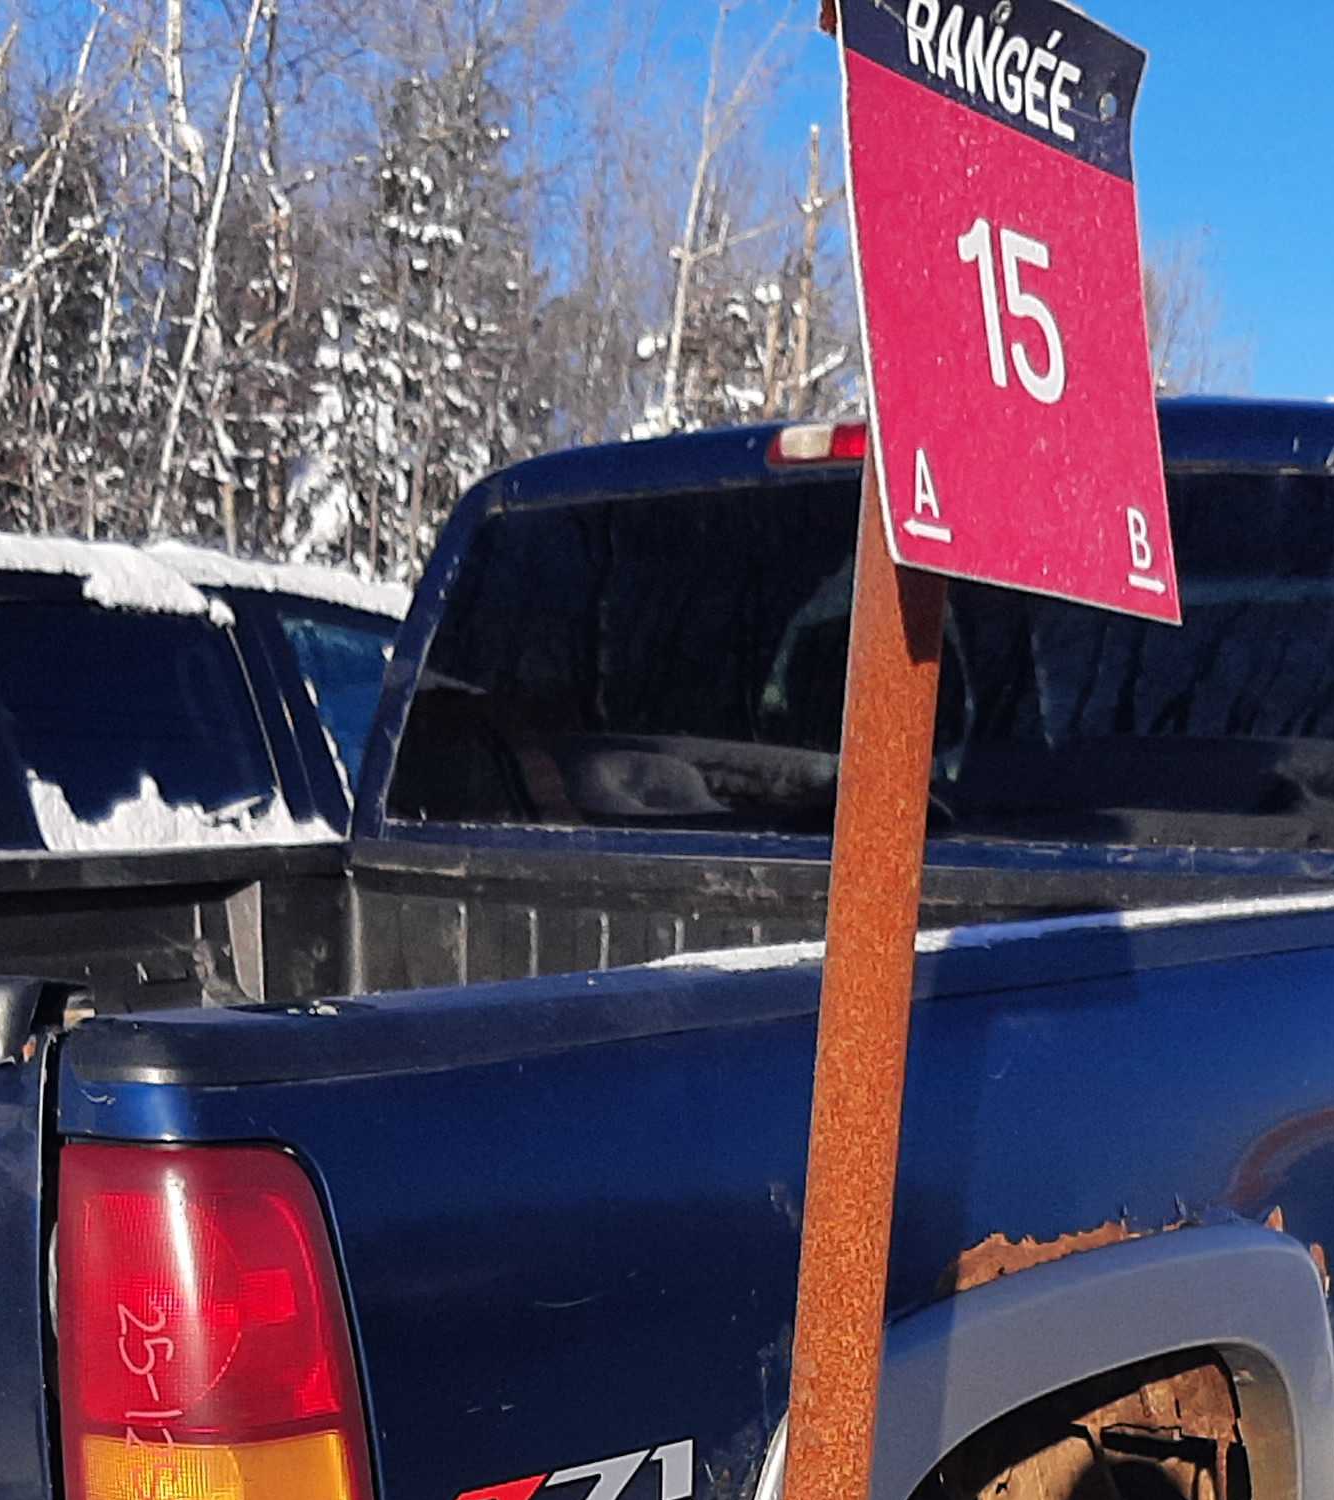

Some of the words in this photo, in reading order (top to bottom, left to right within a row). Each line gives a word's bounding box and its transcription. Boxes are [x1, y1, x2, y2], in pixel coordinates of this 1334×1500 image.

[905, 0, 1082, 141] RANGÉE
[957, 217, 1066, 404] 15
[913, 448, 940, 519] A
[1127, 507, 1152, 570] B
